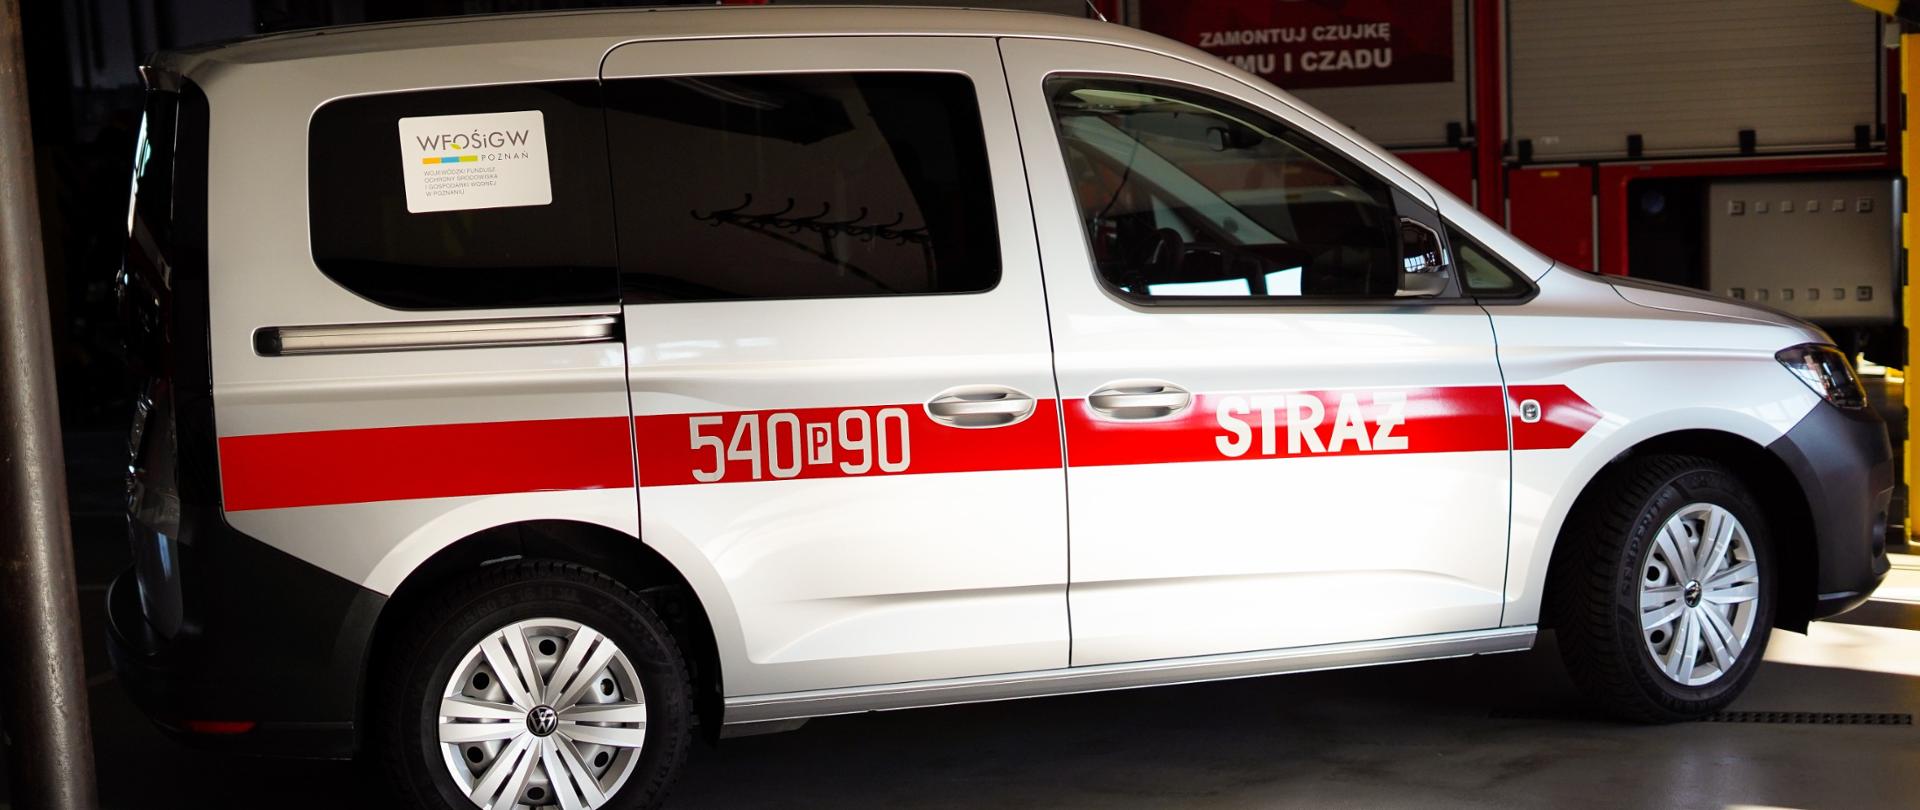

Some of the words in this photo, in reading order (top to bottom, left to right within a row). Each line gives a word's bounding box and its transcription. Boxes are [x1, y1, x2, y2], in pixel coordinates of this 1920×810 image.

[1200, 27, 1306, 47] ZAMONTUJ
[1312, 22, 1390, 41] CZUJKĘ
[1223, 54, 1275, 73] MU
[1284, 52, 1292, 72] I
[1301, 48, 1392, 71] CZADU
[481, 150, 529, 161] POZNAŃ
